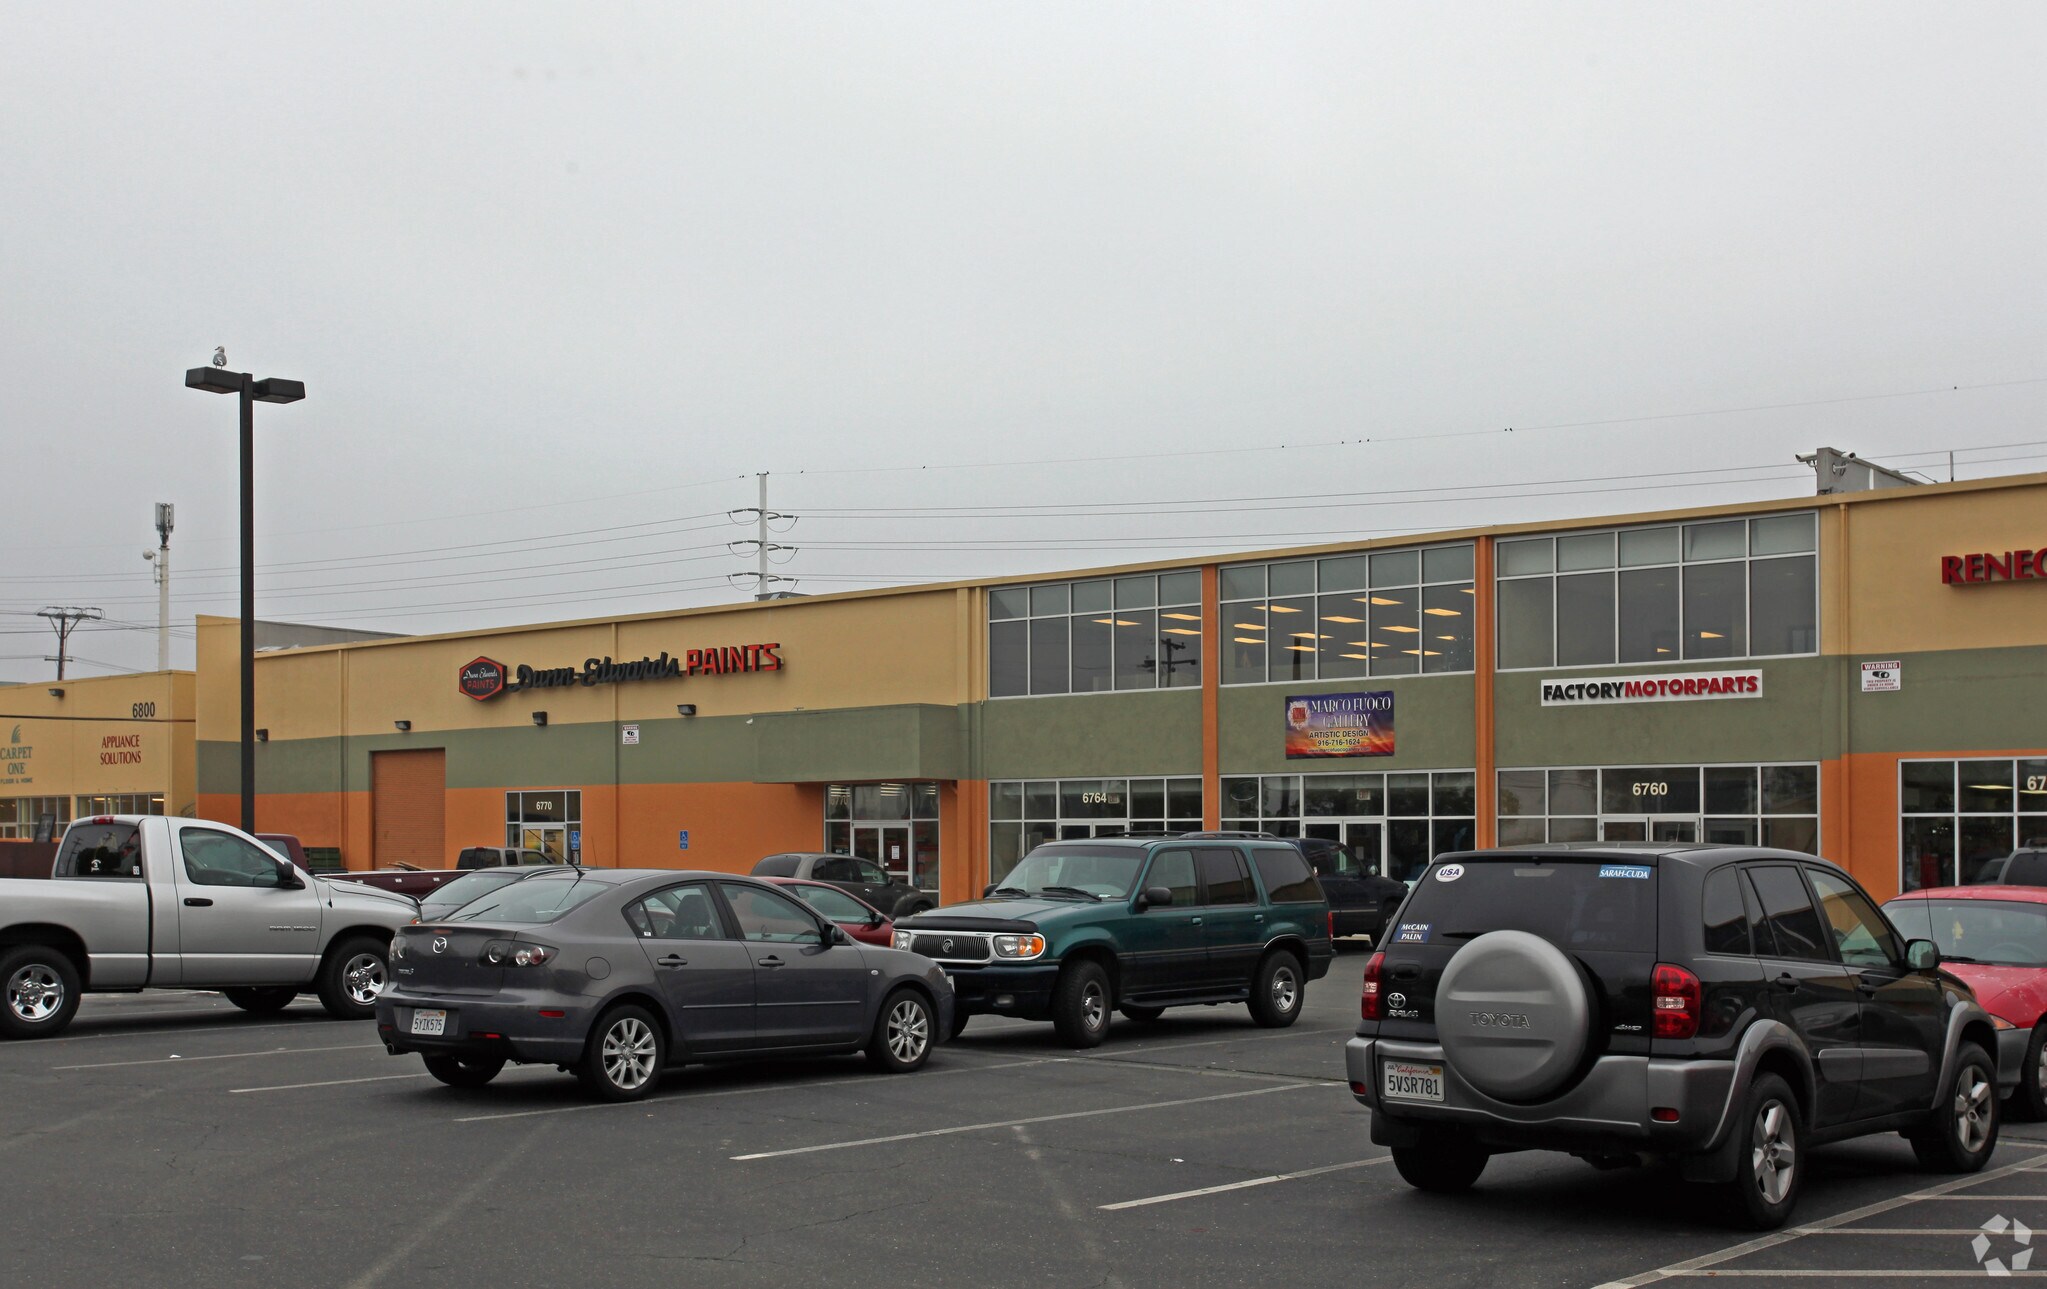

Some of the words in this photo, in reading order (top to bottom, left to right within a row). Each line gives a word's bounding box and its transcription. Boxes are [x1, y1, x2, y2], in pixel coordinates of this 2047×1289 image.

[686, 643, 783, 676] PAINTS
[467, 679, 495, 689] PAINTS
[132, 702, 156, 718] 6800
[1311, 698, 1351, 713] MARCO
[1353, 696, 1391, 711] FUOCO
[1322, 713, 1371, 728] GALLERY
[1309, 730, 1340, 739] ARTISTIC
[1342, 729, 1369, 738] DESIGN
[101, 735, 140, 748] APPLIANCE
[0, 746, 33, 760] CARPET
[100, 750, 141, 765] SOLUTIONS
[7, 762, 26, 775] ONE
[1632, 782, 1668, 796] 6760
[2026, 776, 2047, 790] 67
[1082, 792, 1107, 804] 6764
[536, 801, 553, 811] 6770
[1440, 868, 1460, 876] USA
[1599, 869, 1649, 879] SARAH-CUDA
[1401, 923, 1429, 931] McCAIN
[1469, 1011, 1531, 1029] TOYOTA
[1387, 1074, 1440, 1096] 5VSR781
